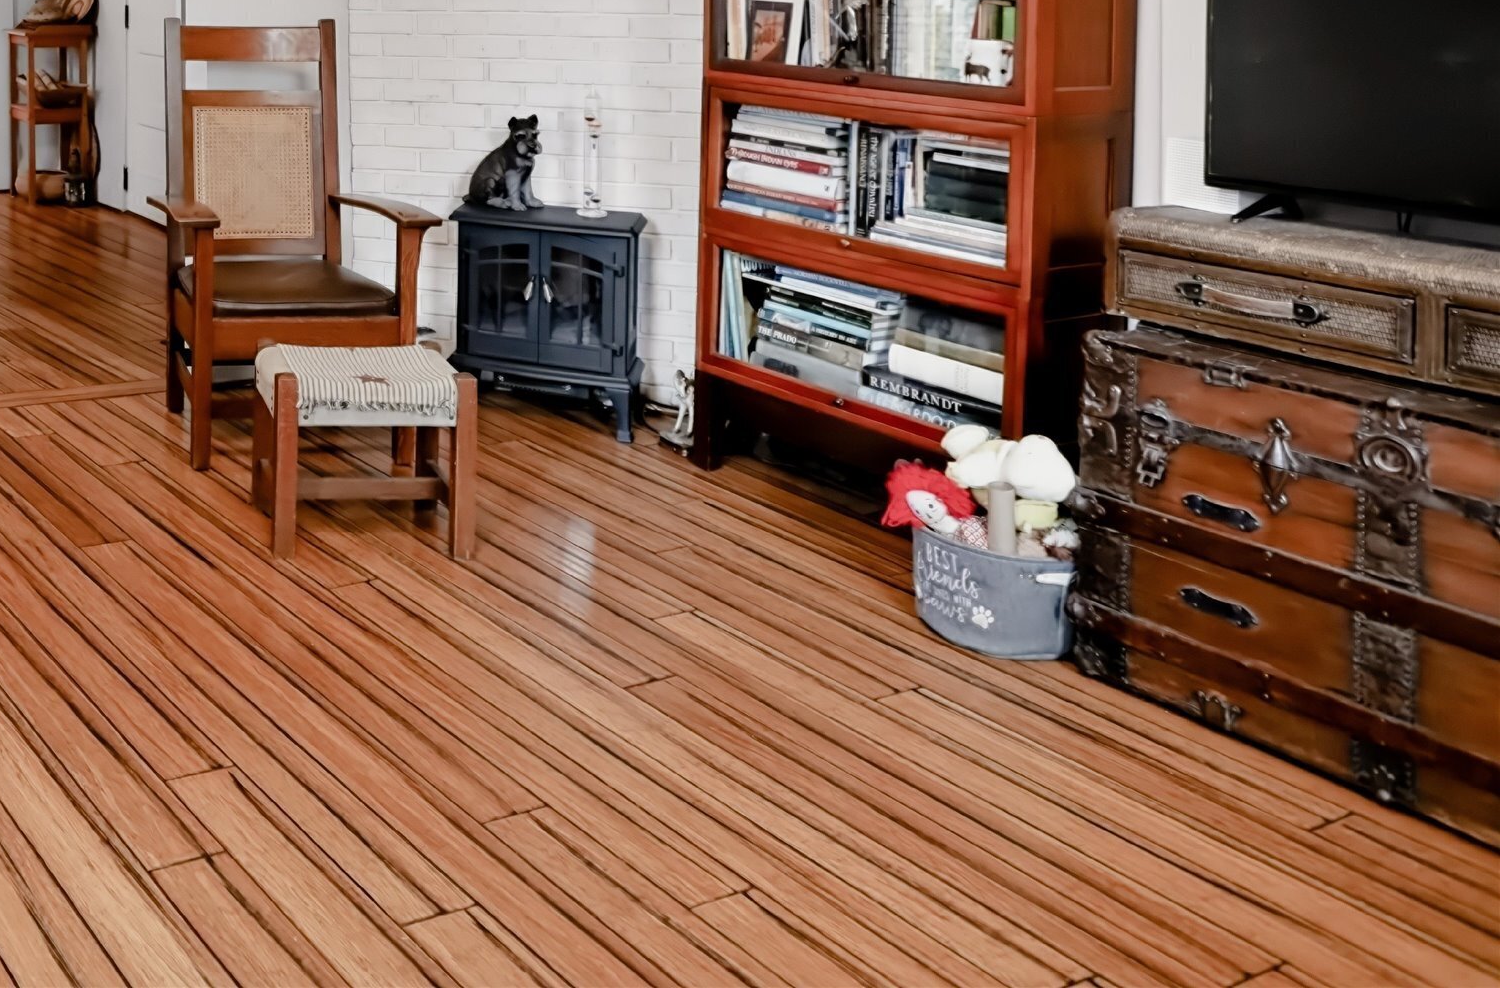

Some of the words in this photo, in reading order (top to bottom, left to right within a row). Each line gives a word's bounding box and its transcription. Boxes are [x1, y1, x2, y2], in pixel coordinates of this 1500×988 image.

[758, 324, 772, 338] THE
[772, 328, 797, 345] PRADO
[870, 375, 962, 413] REMBRANDT
[925, 542, 958, 576] BEST
